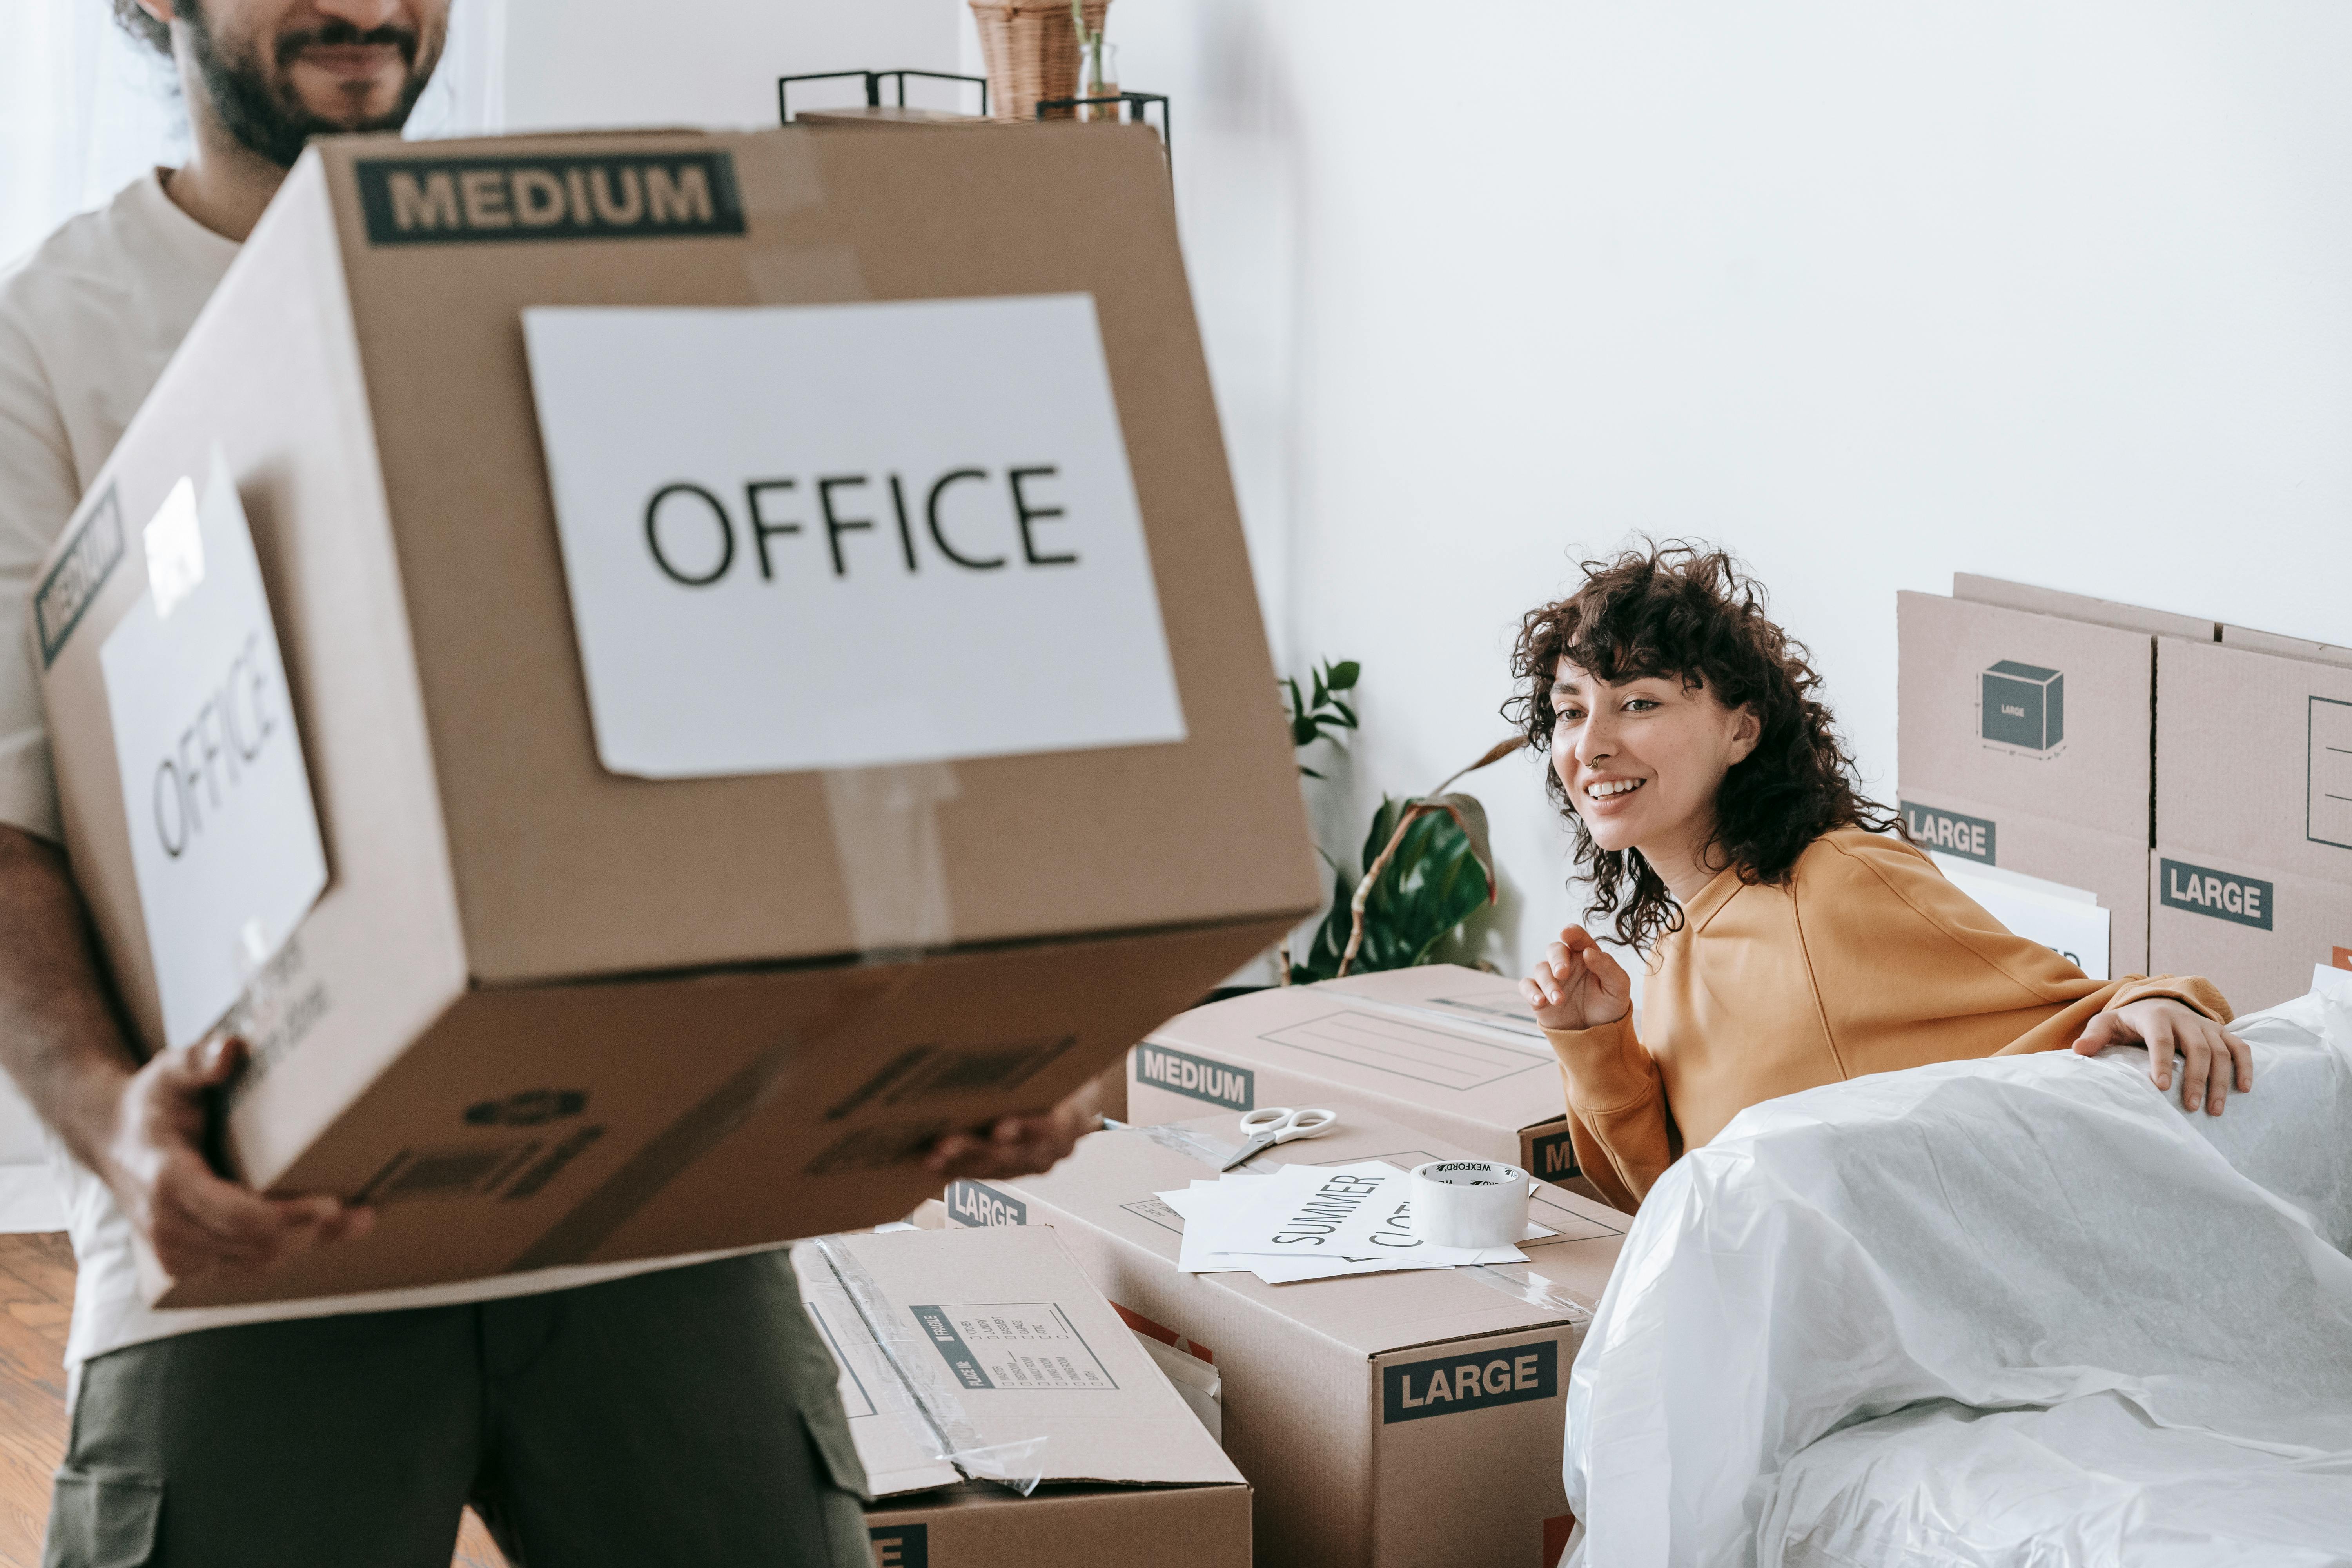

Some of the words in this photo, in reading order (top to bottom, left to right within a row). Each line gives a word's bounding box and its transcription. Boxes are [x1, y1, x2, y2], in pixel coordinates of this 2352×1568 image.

[391, 165, 713, 229] MEDIUM
[644, 466, 1077, 587] OFFICE
[2001, 704, 2024, 717] LARGE
[153, 630, 275, 859] OFFICE
[1909, 810, 1986, 856] LARGE
[2171, 868, 2261, 918] LARGE
[1144, 1049, 1245, 1104] MEDIUM
[1446, 1163, 1491, 1172] WEXFORD
[955, 1181, 1018, 1227] LARGE
[1272, 1175, 1385, 1245] SUMMER
[923, 1315, 949, 1335] FRAGILE
[959, 1320, 978, 1335] KITCHEN
[975, 1319, 995, 1334] LAUNDRY
[991, 1316, 1013, 1334] BASEMENT
[1011, 1320, 1029, 1334] GARAGE
[1032, 1324, 1047, 1334] ATTIC
[1020, 1357, 1036, 1368] ROOM
[1038, 1357, 1054, 1368] ROOM
[1055, 1357, 1072, 1368] ROOM
[960, 1368, 984, 1386] PLACE
[992, 1366, 1010, 1380] MASTER
[1028, 1368, 1045, 1380] FAMILY
[1047, 1368, 1063, 1380] LIVING
[1064, 1368, 1081, 1380] DINING
[1083, 1371, 1099, 1380] BATH
[1402, 1354, 1538, 1409] LARGE
